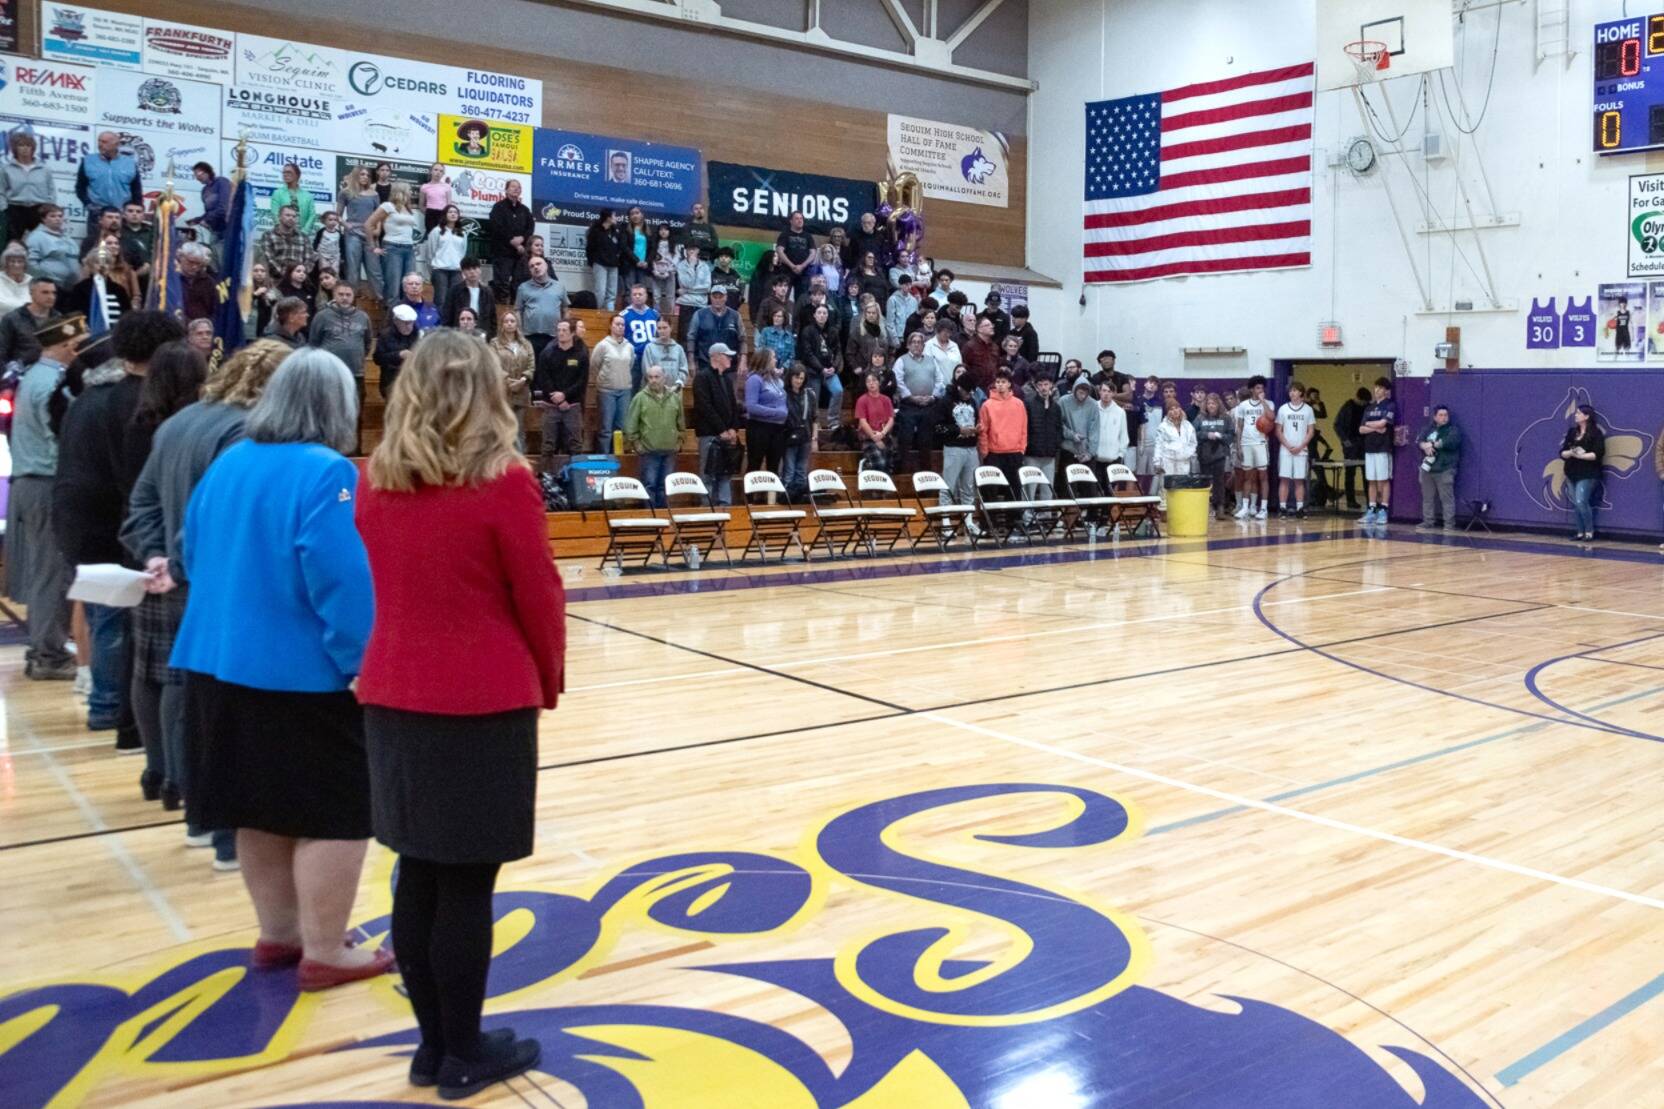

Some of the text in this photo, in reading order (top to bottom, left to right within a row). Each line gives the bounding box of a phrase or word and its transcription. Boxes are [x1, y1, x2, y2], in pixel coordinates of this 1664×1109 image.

[145, 27, 232, 49] FRANKFURTH
[1597, 22, 1640, 43] HOME
[1621, 39, 1640, 76] 0
[269, 56, 330, 80] Sequim
[15, 66, 87, 91] RE/MAX
[248, 72, 290, 86] VISION
[294, 79, 336, 92] CLINIC
[384, 76, 447, 96] CEDARS
[467, 71, 525, 90] FLOORING
[1616, 81, 1645, 92] BONUS
[49, 90, 89, 103] Avenue
[229, 88, 330, 111] LONGHOUSE
[457, 87, 534, 108] LIQUIDATORS
[460, 104, 530, 123] 360-477-4237
[1594, 101, 1624, 112] FOULS
[101, 111, 153, 127] Supports
[156, 120, 175, 130] the
[178, 122, 215, 135] Wolves
[241, 111, 284, 123] MARKET
[900, 122, 985, 144] SEQUIM HIGH SCHOOL
[1602, 111, 1621, 148] 0
[900, 133, 957, 151] HALL OF FAME
[263, 152, 324, 170] Allstate
[900, 145, 947, 161] COMMITTEE
[541, 158, 600, 173] FARMERS
[665, 160, 695, 171] AGENCY
[550, 170, 590, 180] INSURANCE
[1638, 179, 1664, 192] Visit
[574, 192, 590, 200] Drive
[1632, 197, 1650, 208] For
[563, 209, 585, 218] Proud
[732, 187, 850, 223] SENIORS
[630, 320, 658, 343] 80
[1532, 326, 1553, 343] 30
[1573, 325, 1584, 342] 3
[1292, 422, 1299, 432] 4
[672, 477, 698, 487] SEQUIM
[750, 475, 776, 485] SEQUIM
[813, 473, 837, 484] SEQUIM
[863, 474, 888, 484] SEQUIM
